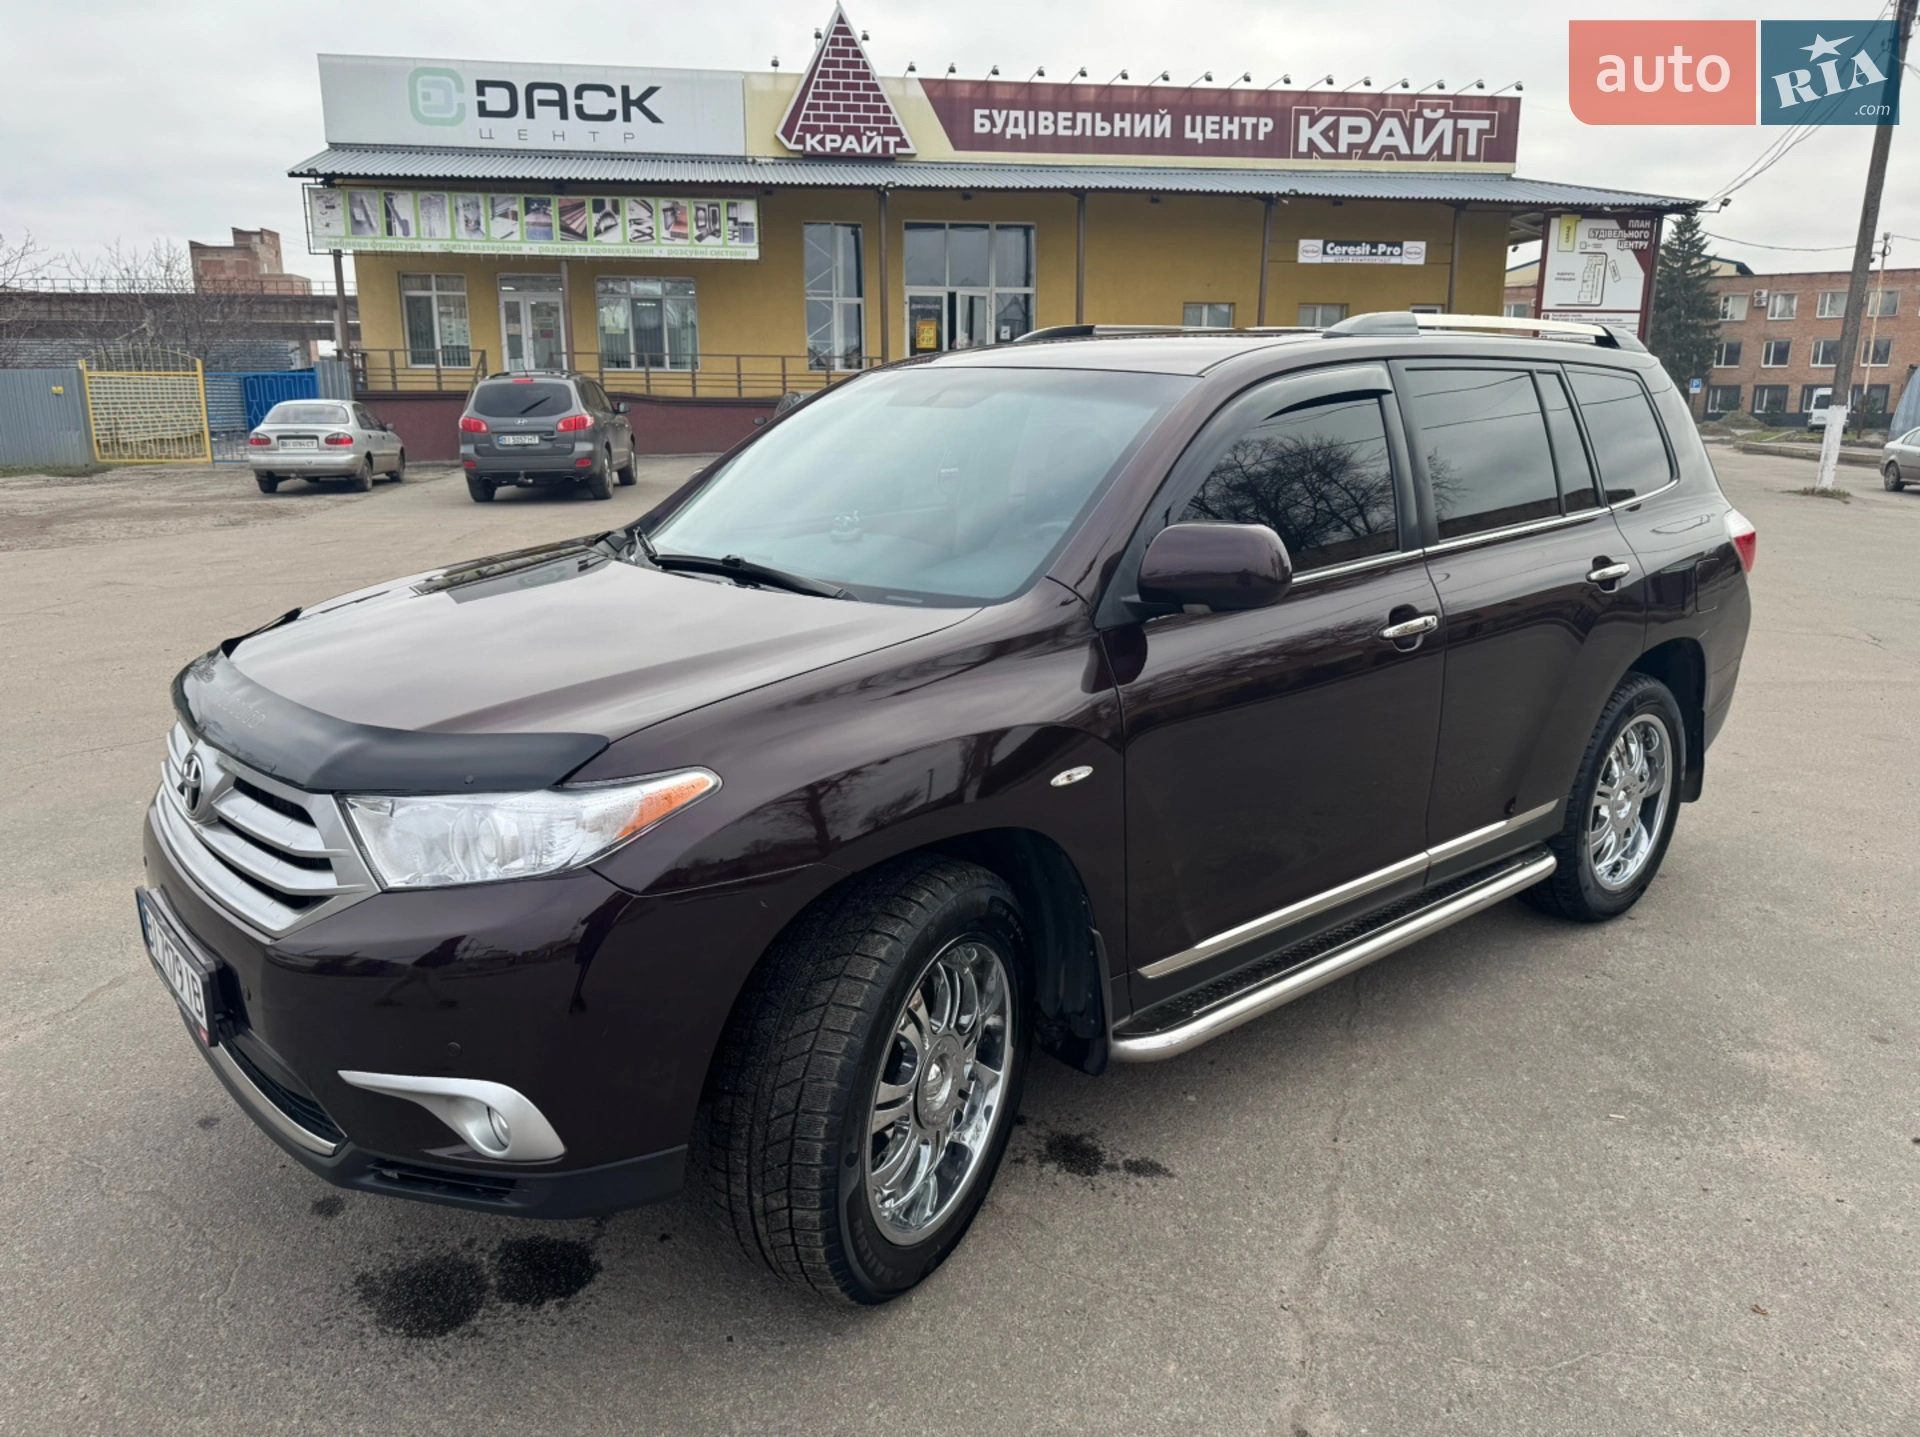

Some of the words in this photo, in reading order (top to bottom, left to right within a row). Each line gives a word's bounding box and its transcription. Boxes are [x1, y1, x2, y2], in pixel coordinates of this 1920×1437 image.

[475, 79, 665, 124] DACK
[478, 127, 636, 144] ЦЕНТР
[973, 108, 1172, 141] БУДІВЕЛЬНИЙ
[1183, 114, 1275, 143] ЦЕНТР
[1297, 108, 1491, 156] КРАЙТ
[805, 130, 899, 155] КРАЙТ
[1628, 220, 1651, 229] ПЛАН
[1588, 228, 1650, 240] БУДІВЕЛЬНОГО
[1325, 242, 1402, 256] Ceresit-Pro
[1617, 240, 1649, 250] ЦЕНТРУ
